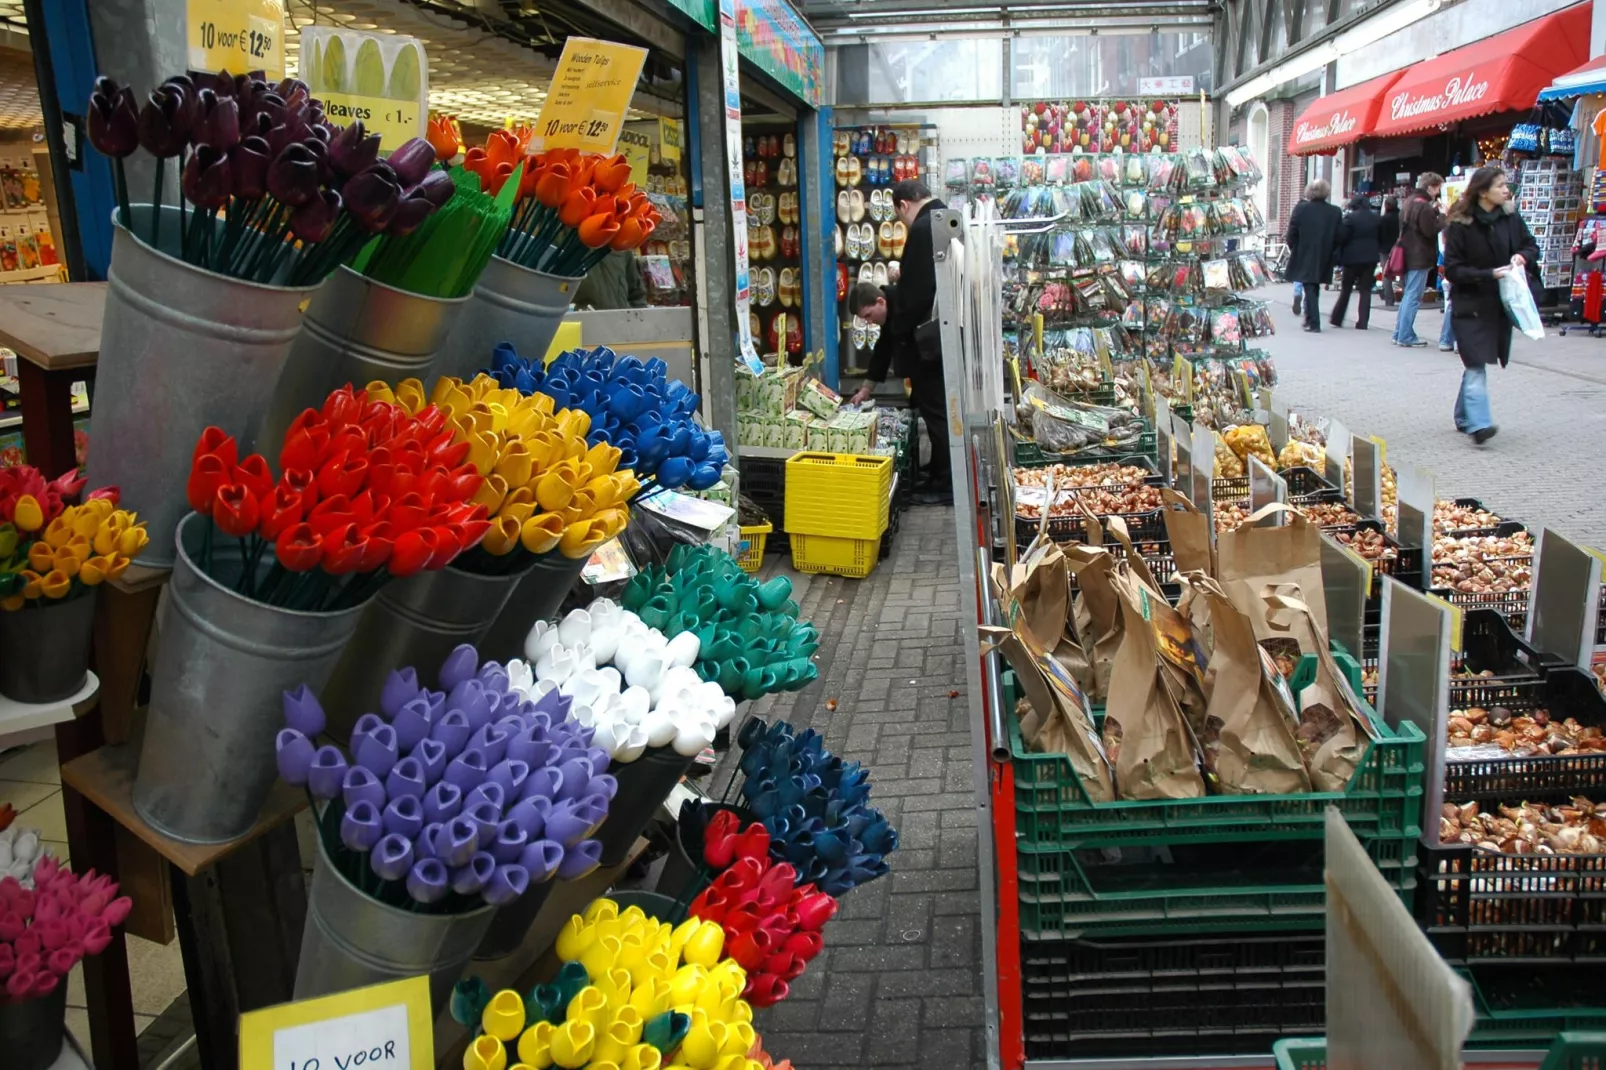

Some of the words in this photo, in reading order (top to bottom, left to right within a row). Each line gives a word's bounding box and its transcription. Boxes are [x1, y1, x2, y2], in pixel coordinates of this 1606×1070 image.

[201, 21, 215, 49] 10
[217, 31, 238, 48] voor
[570, 52, 592, 64] Wooden
[1391, 92, 1442, 120] Christmas
[1441, 72, 1489, 108] Palace
[544, 120, 560, 136] 10
[560, 123, 579, 134] voor
[1296, 122, 1329, 144] Christmas
[1328, 110, 1356, 136] Palace
[334, 1040, 396, 1070] VOOR
